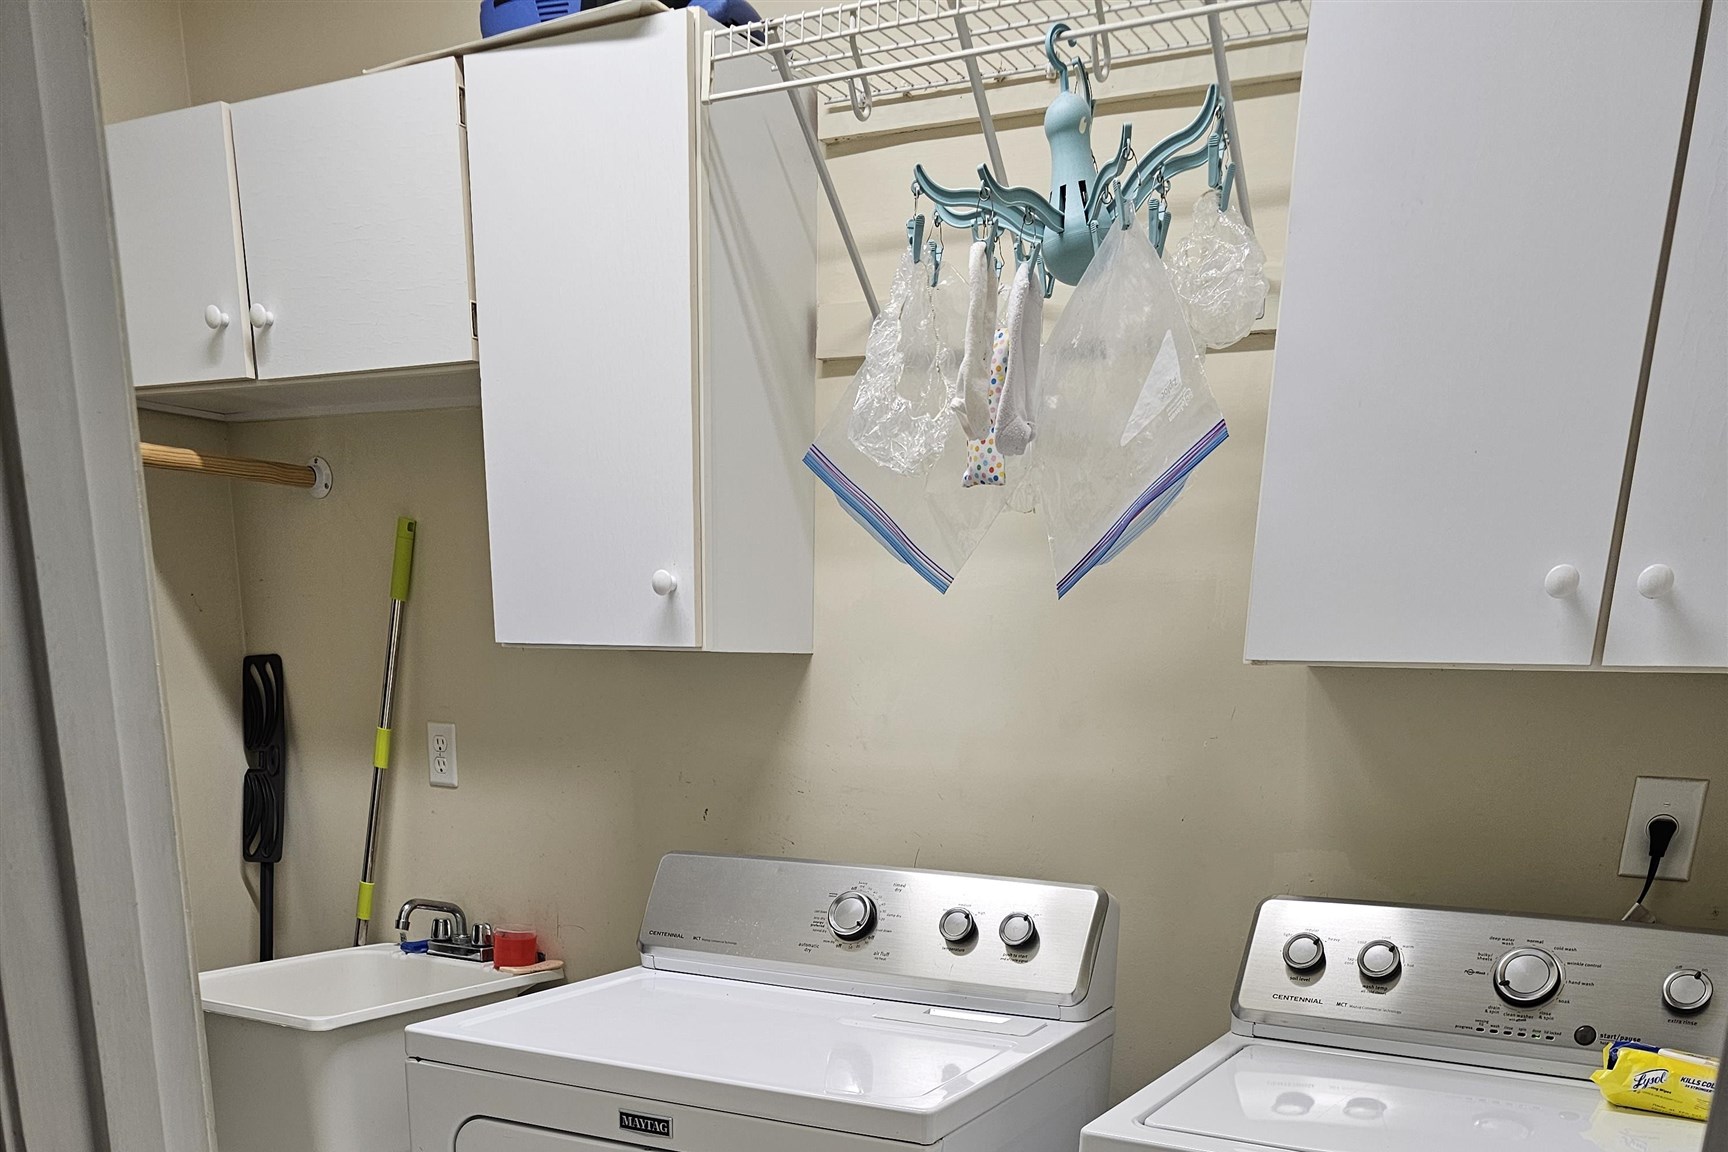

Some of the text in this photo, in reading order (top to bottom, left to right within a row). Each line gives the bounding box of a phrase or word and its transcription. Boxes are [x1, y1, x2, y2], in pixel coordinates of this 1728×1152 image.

[649, 930, 684, 939] CENTENNIAL
[1272, 993, 1323, 1005] CENTENNIAL
[1599, 1032, 1642, 1043] start/pause
[1633, 1071, 1666, 1089] Lysol
[1680, 1076, 1702, 1086] KILLS
[621, 1114, 668, 1133] MAYTAG
